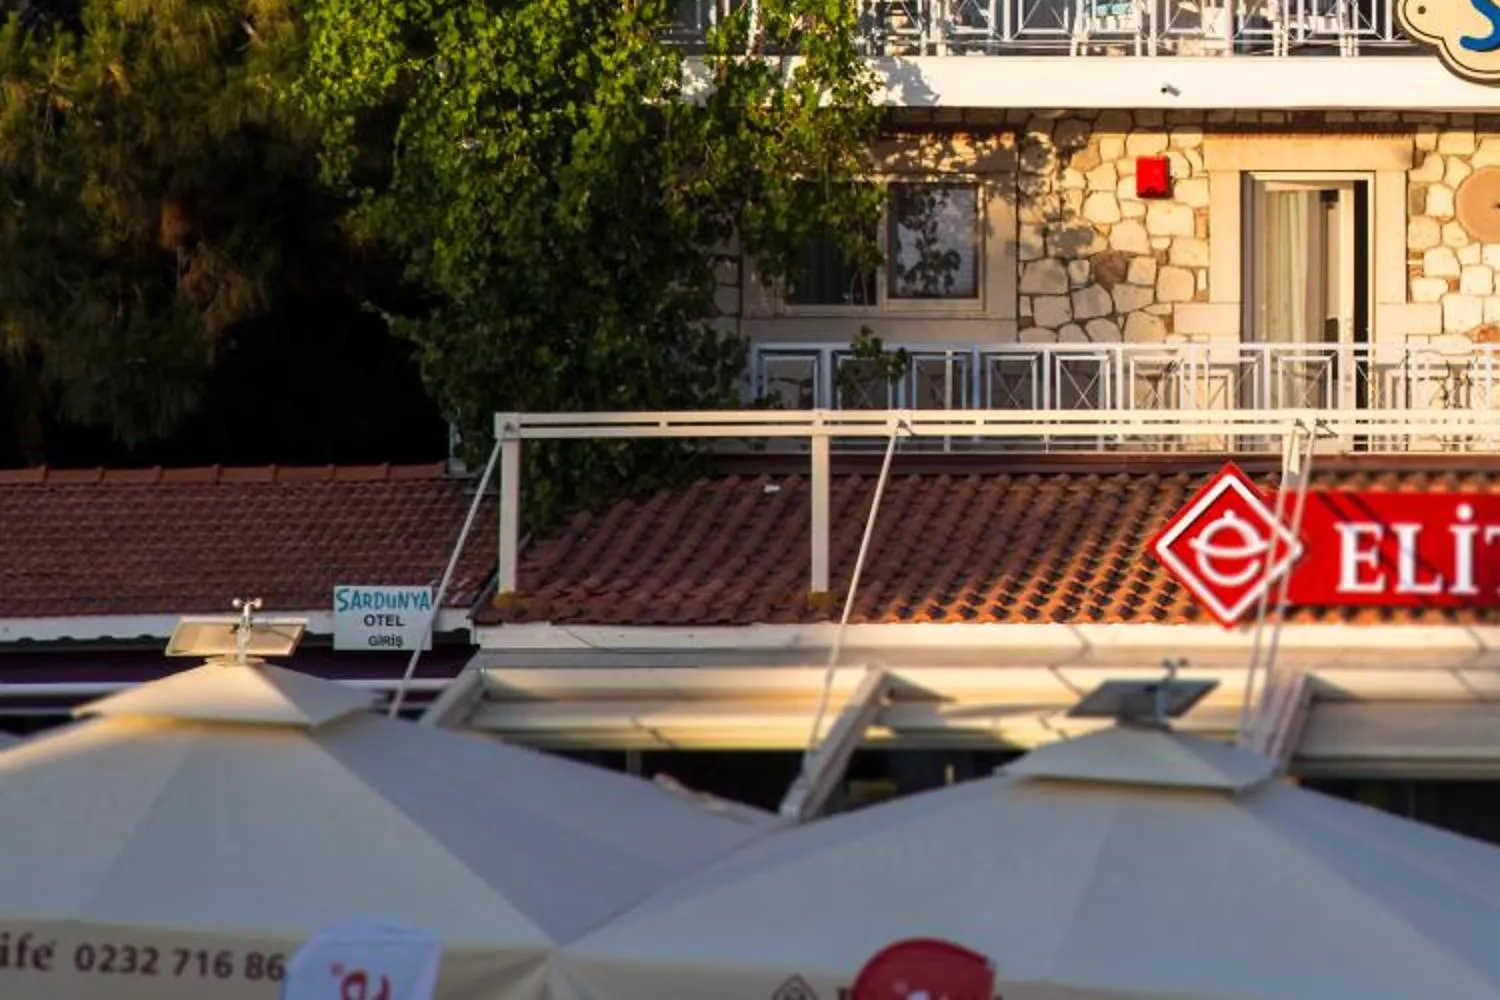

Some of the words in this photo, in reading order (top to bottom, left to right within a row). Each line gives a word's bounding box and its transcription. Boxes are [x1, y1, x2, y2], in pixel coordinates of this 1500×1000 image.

[335, 588, 430, 613] SARDUNYA
[363, 613, 406, 627] OTEL
[0, 931, 55, 971] ife
[74, 942, 160, 974] 0232
[173, 948, 234, 979] 716
[244, 951, 285, 982] 86
